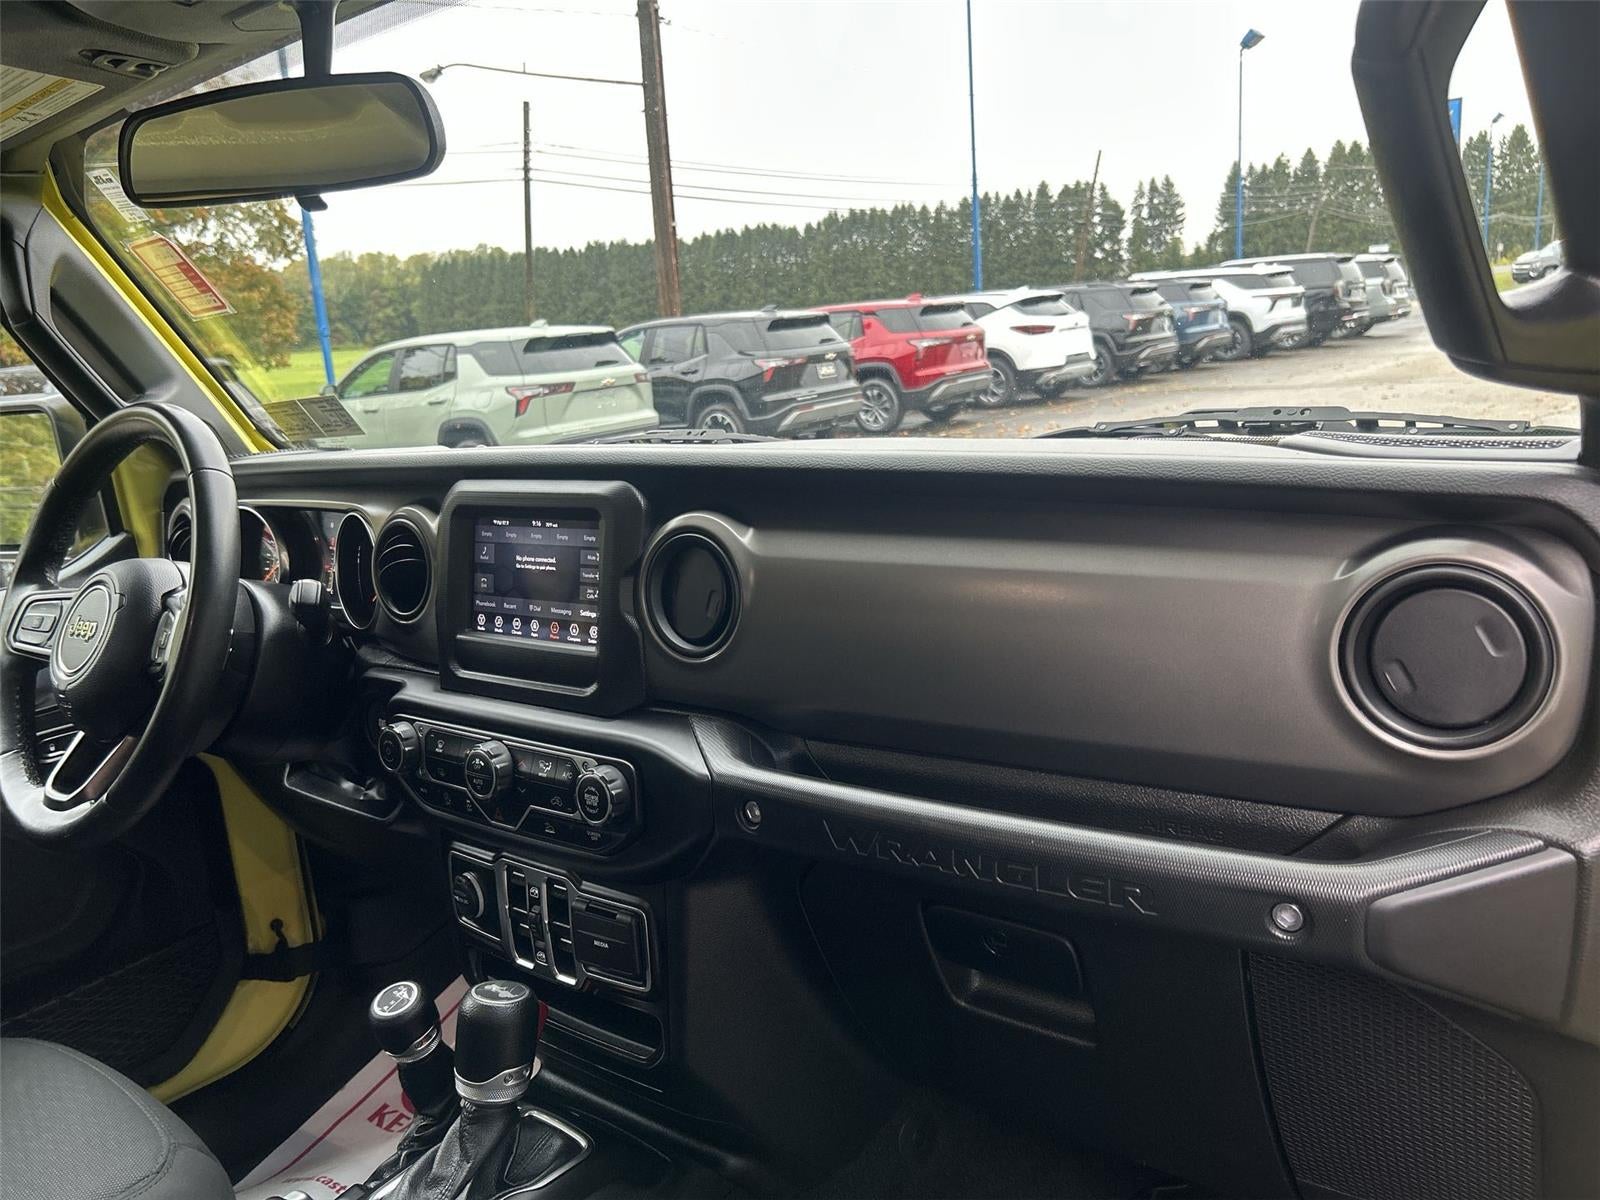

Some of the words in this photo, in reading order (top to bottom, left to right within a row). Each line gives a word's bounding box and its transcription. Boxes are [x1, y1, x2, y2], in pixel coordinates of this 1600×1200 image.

[70, 614, 98, 641] Jeep
[580, 610, 597, 618] Settings
[822, 818, 1158, 916] WRANGLER
[593, 940, 608, 949] MEDIA
[368, 1102, 412, 1132] KE
